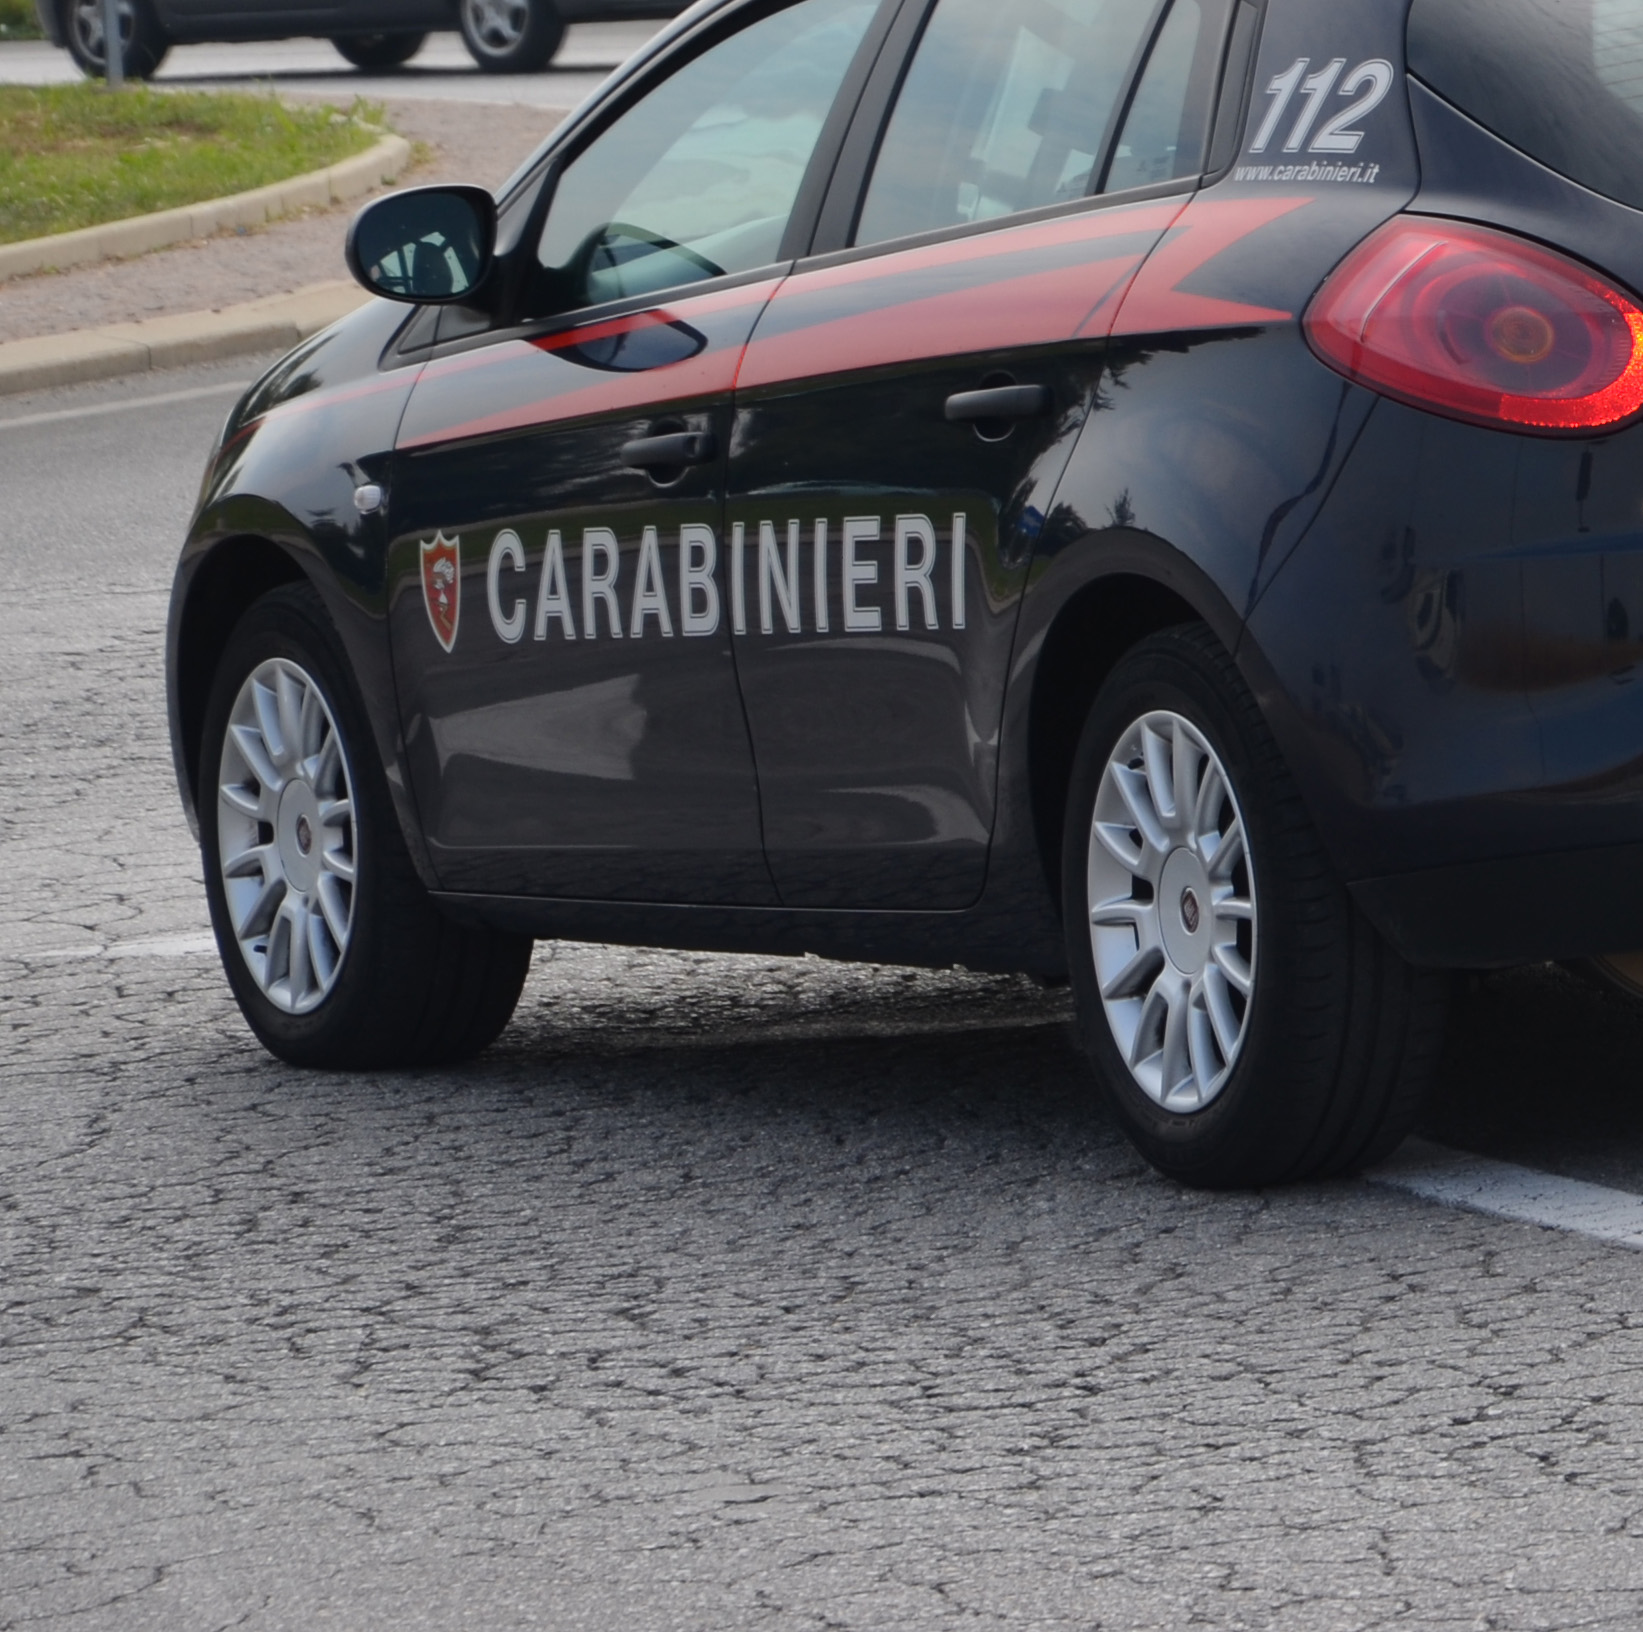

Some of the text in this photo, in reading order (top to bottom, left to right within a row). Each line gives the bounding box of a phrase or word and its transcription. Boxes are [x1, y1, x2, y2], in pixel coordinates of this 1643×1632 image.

[1248, 57, 1395, 154] 112
[1234, 161, 1380, 184] www.carabinieri.it
[487, 512, 967, 644] CARABINIERI
